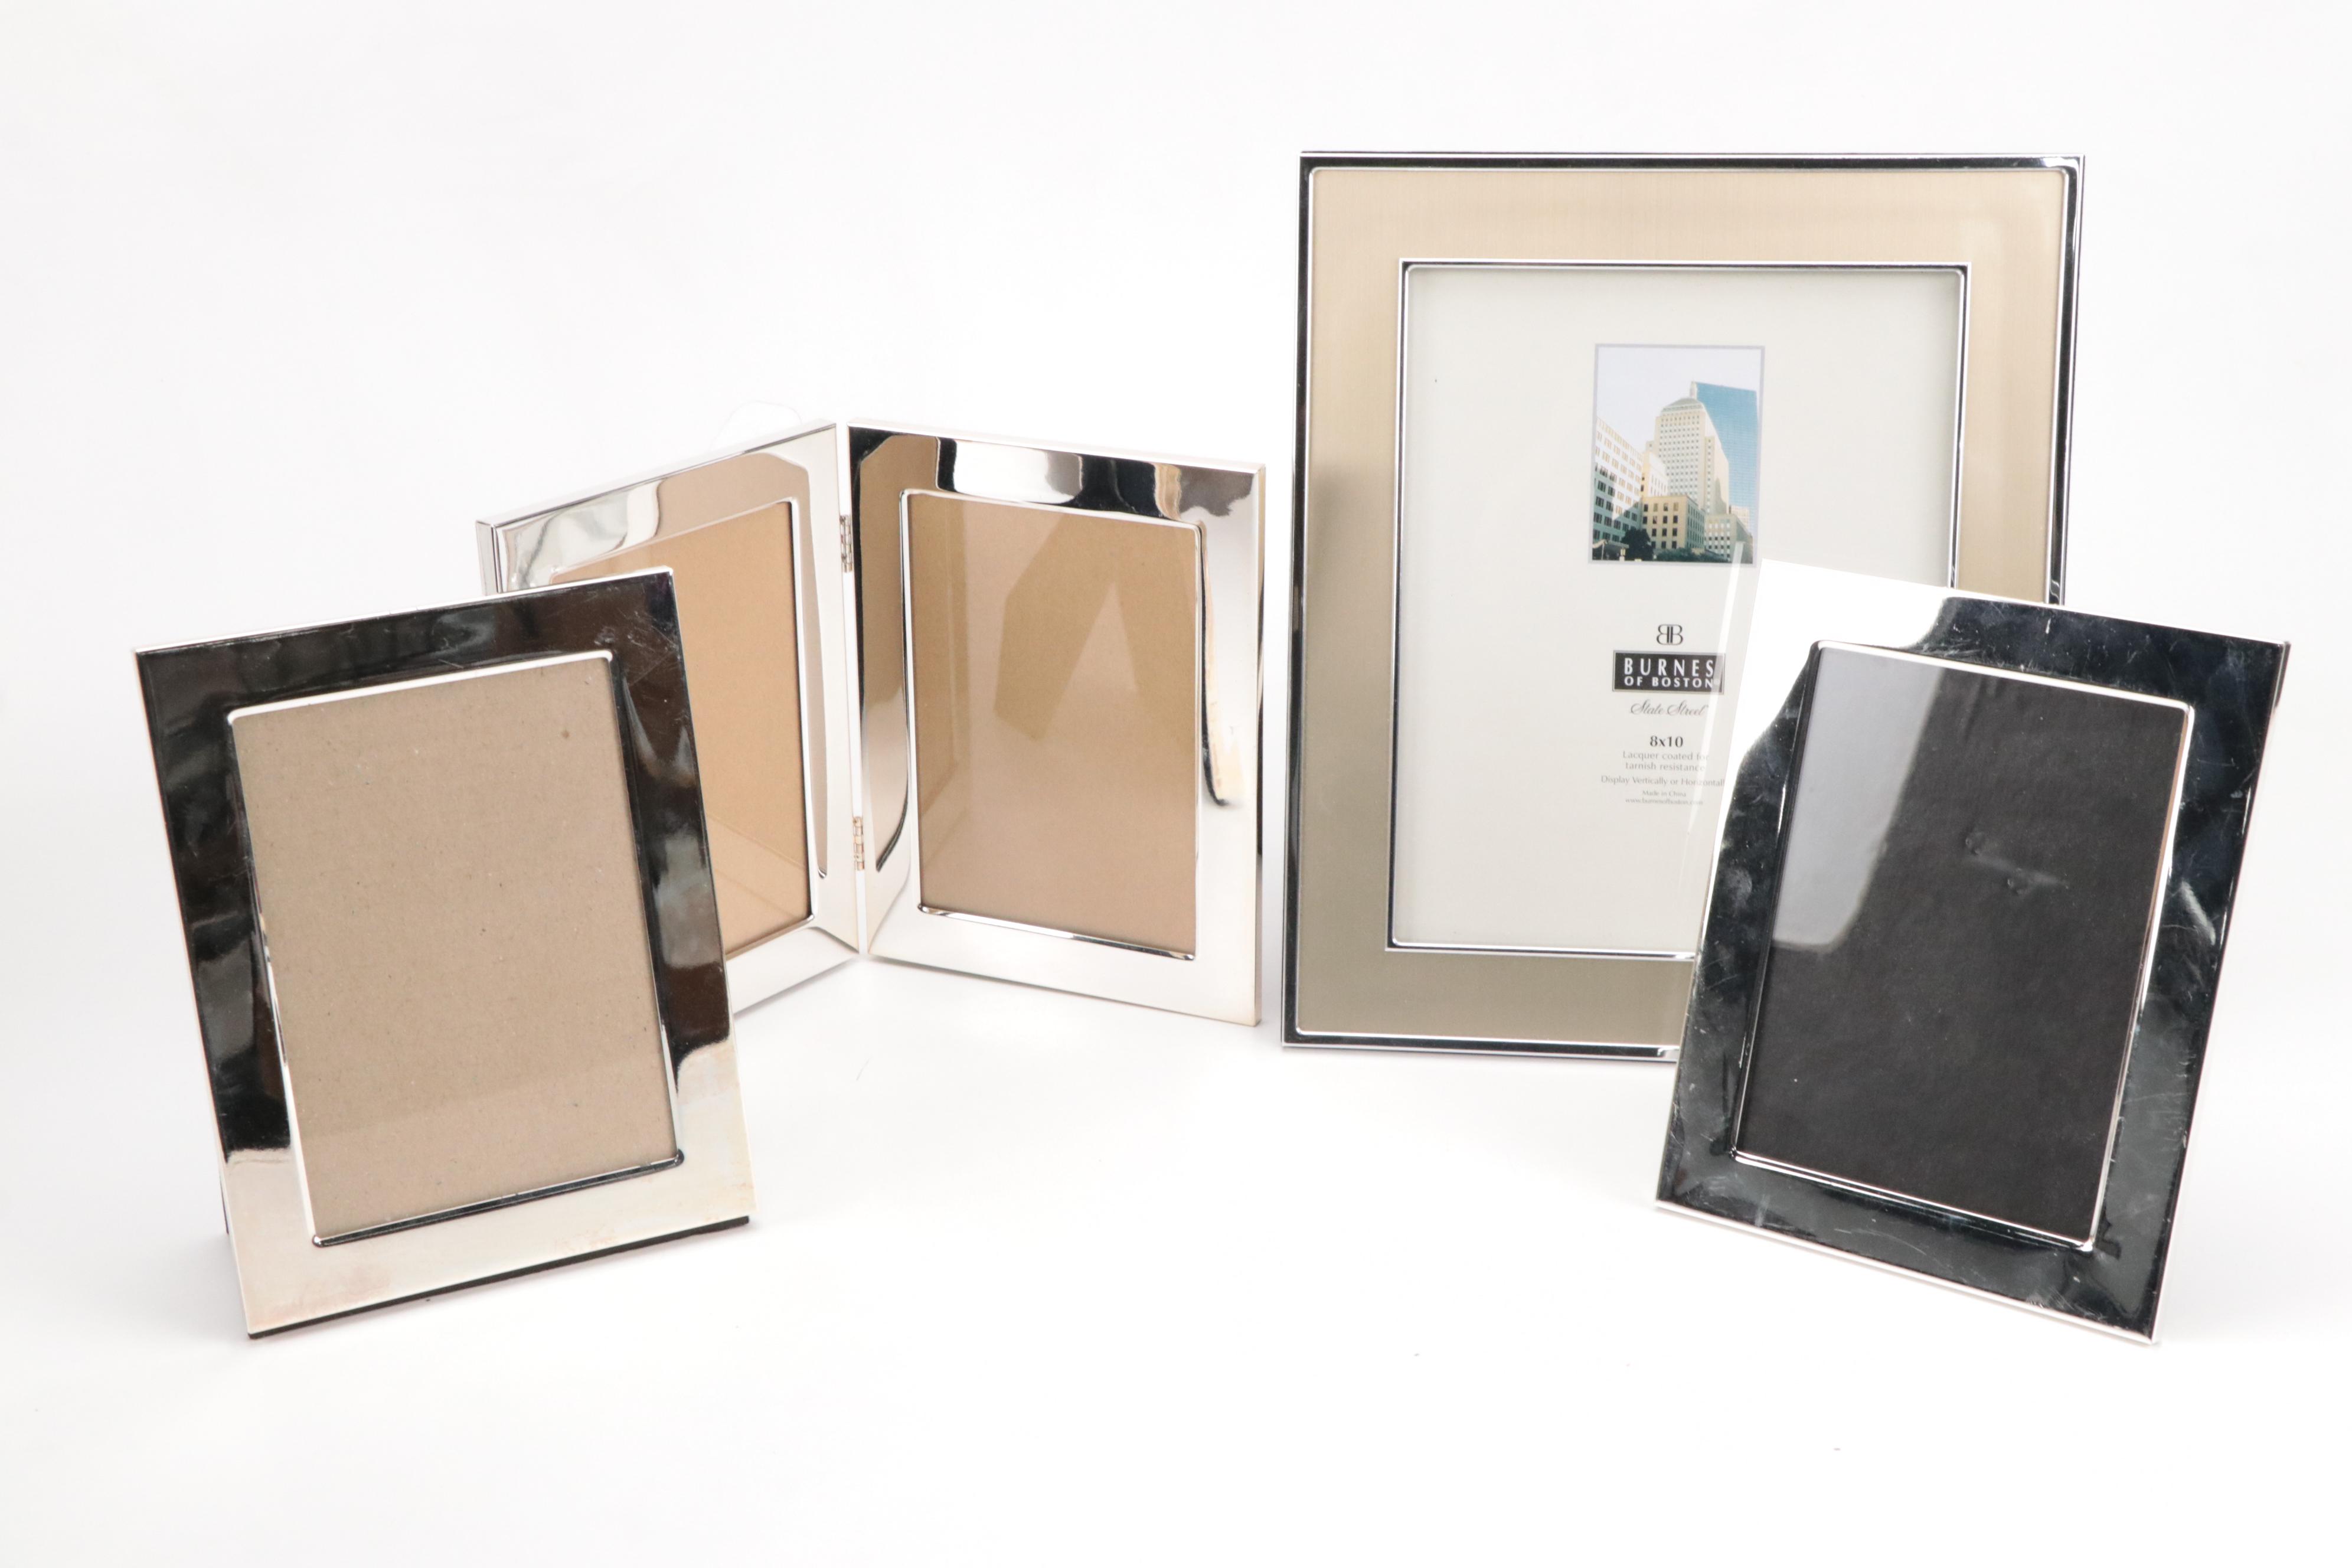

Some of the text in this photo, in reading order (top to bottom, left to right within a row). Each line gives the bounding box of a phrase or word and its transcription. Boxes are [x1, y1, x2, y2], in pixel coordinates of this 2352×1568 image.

[1624, 657, 1714, 677] BURNES
[1624, 676, 1713, 688] OF BOSTON
[1630, 698, 1706, 717] State Street
[1649, 736, 1684, 748] 8x10
[1622, 750, 1658, 761] Lacquer
[1662, 752, 1693, 761] coated
[1625, 762, 1705, 772] tarnish resistance
[1601, 775, 1630, 785] Display
[1632, 776, 1668, 786] Vertically
[1681, 778, 1725, 787] Horizontall
